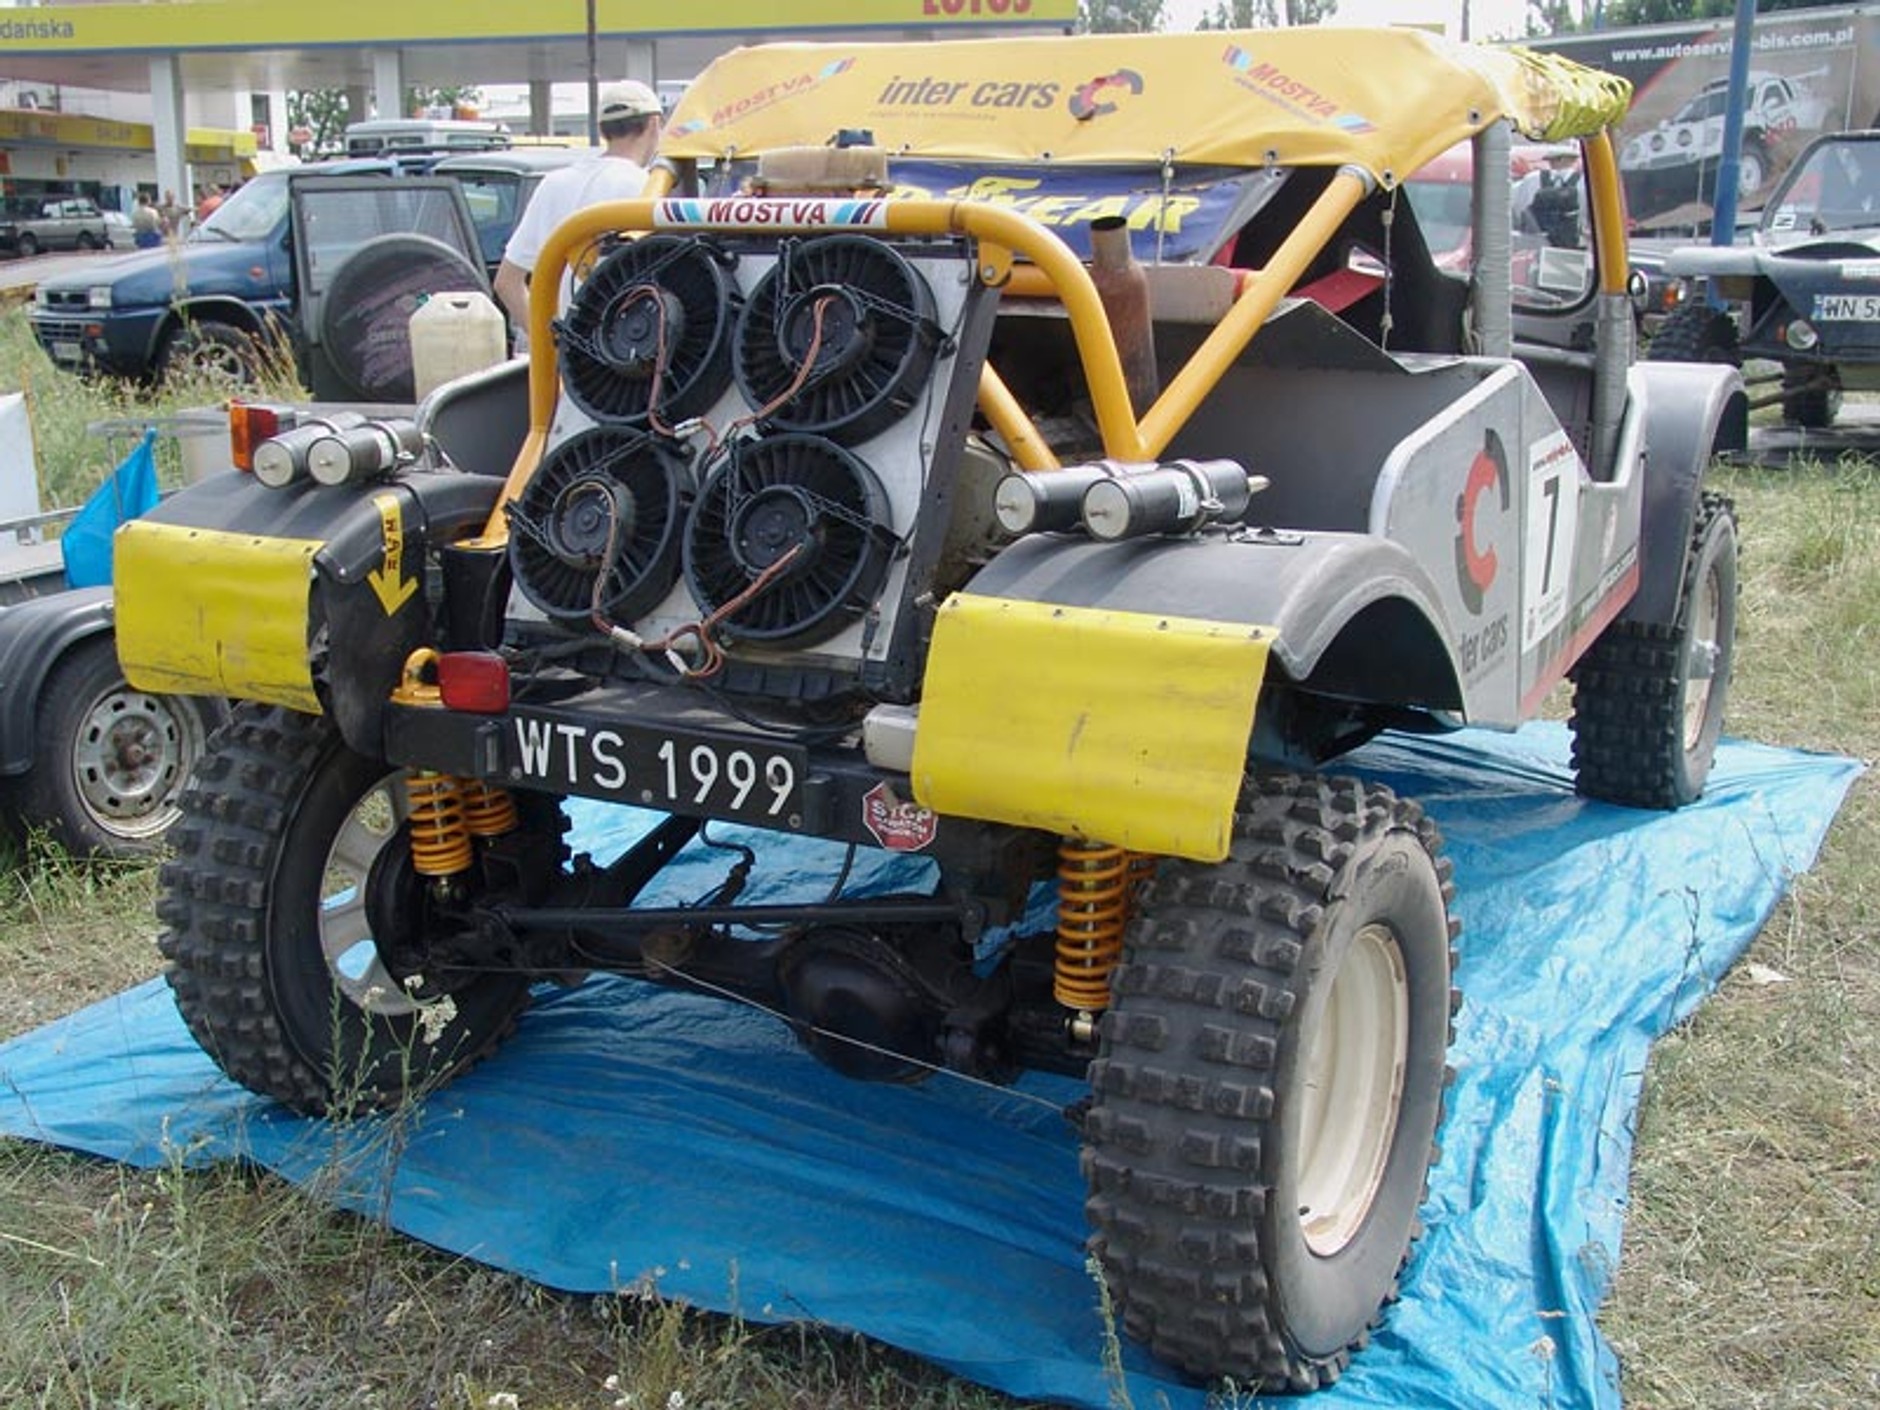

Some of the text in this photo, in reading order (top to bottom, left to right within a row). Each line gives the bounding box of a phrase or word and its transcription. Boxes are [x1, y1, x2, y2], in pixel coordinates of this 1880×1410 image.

[712, 75, 813, 125] MOSTVA
[877, 74, 1061, 110] inter cars
[1247, 61, 1340, 118] MOSTVA
[707, 201, 826, 225] MOSTVA
[1863, 298, 1880, 319] 5
[514, 716, 796, 816] WTS 1999
